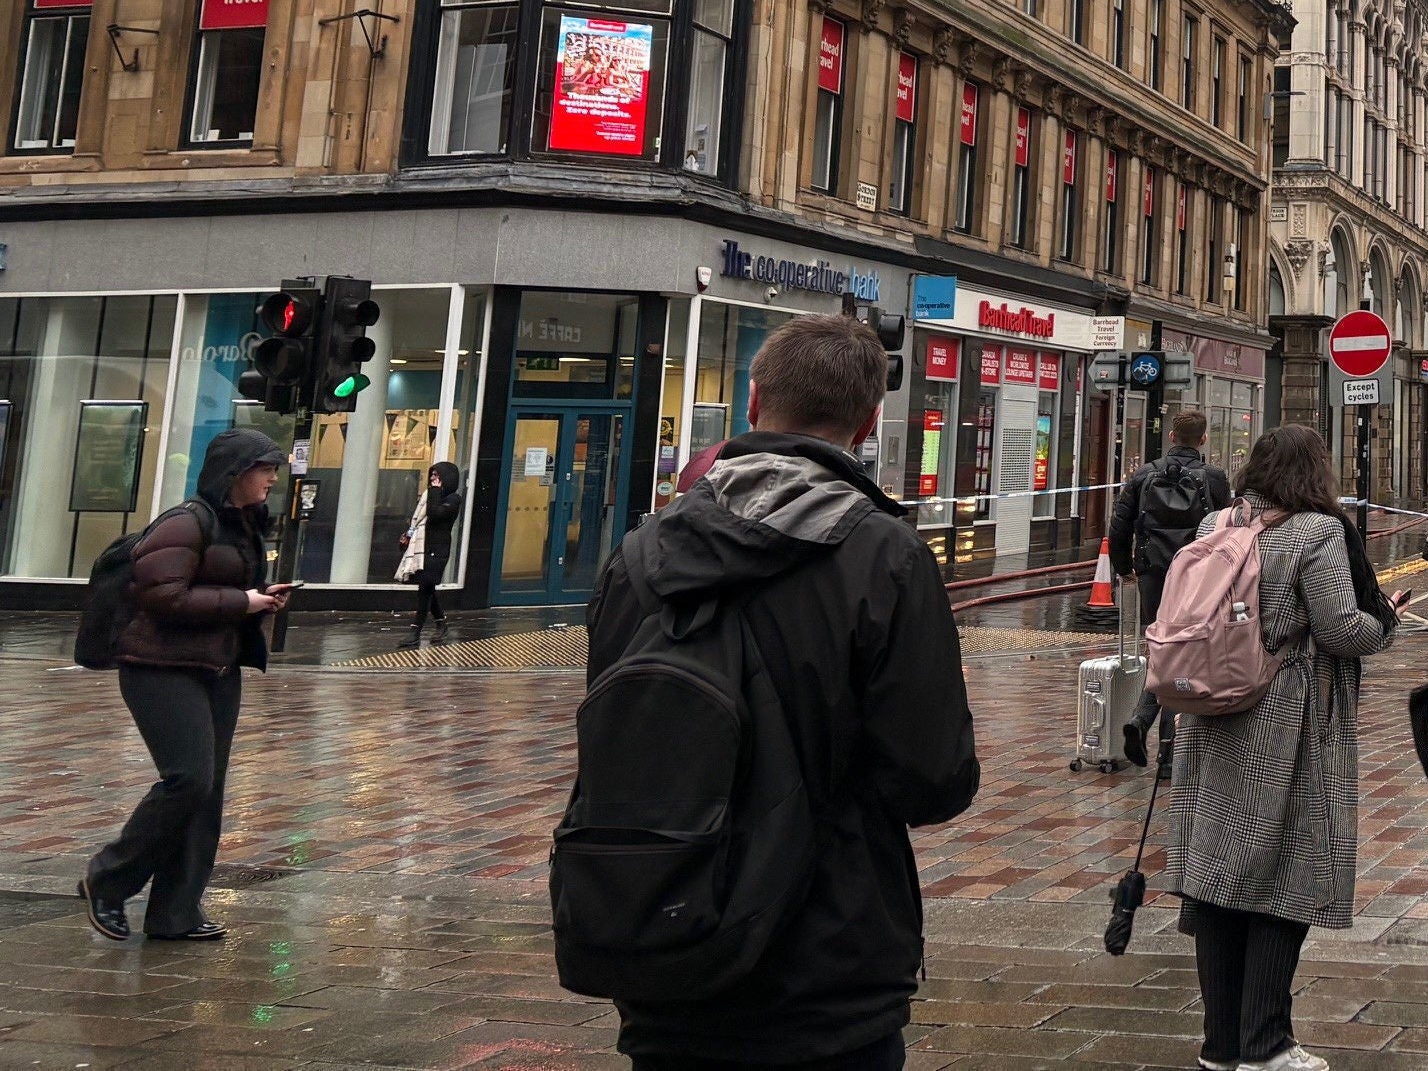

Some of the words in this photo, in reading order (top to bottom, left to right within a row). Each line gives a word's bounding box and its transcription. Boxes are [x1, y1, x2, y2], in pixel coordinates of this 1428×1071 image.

[720, 239, 752, 279] The
[848, 266, 881, 302] bank
[979, 300, 1027, 332] Barrhead
[1025, 308, 1055, 337] Travel
[1092, 318, 1119, 326] Barrhead
[1095, 334, 1115, 342] Foreign
[933, 347, 947, 357] TRAVEL
[932, 356, 947, 365] MONEY
[1346, 382, 1375, 392] Except
[1347, 393, 1374, 401] cycles
